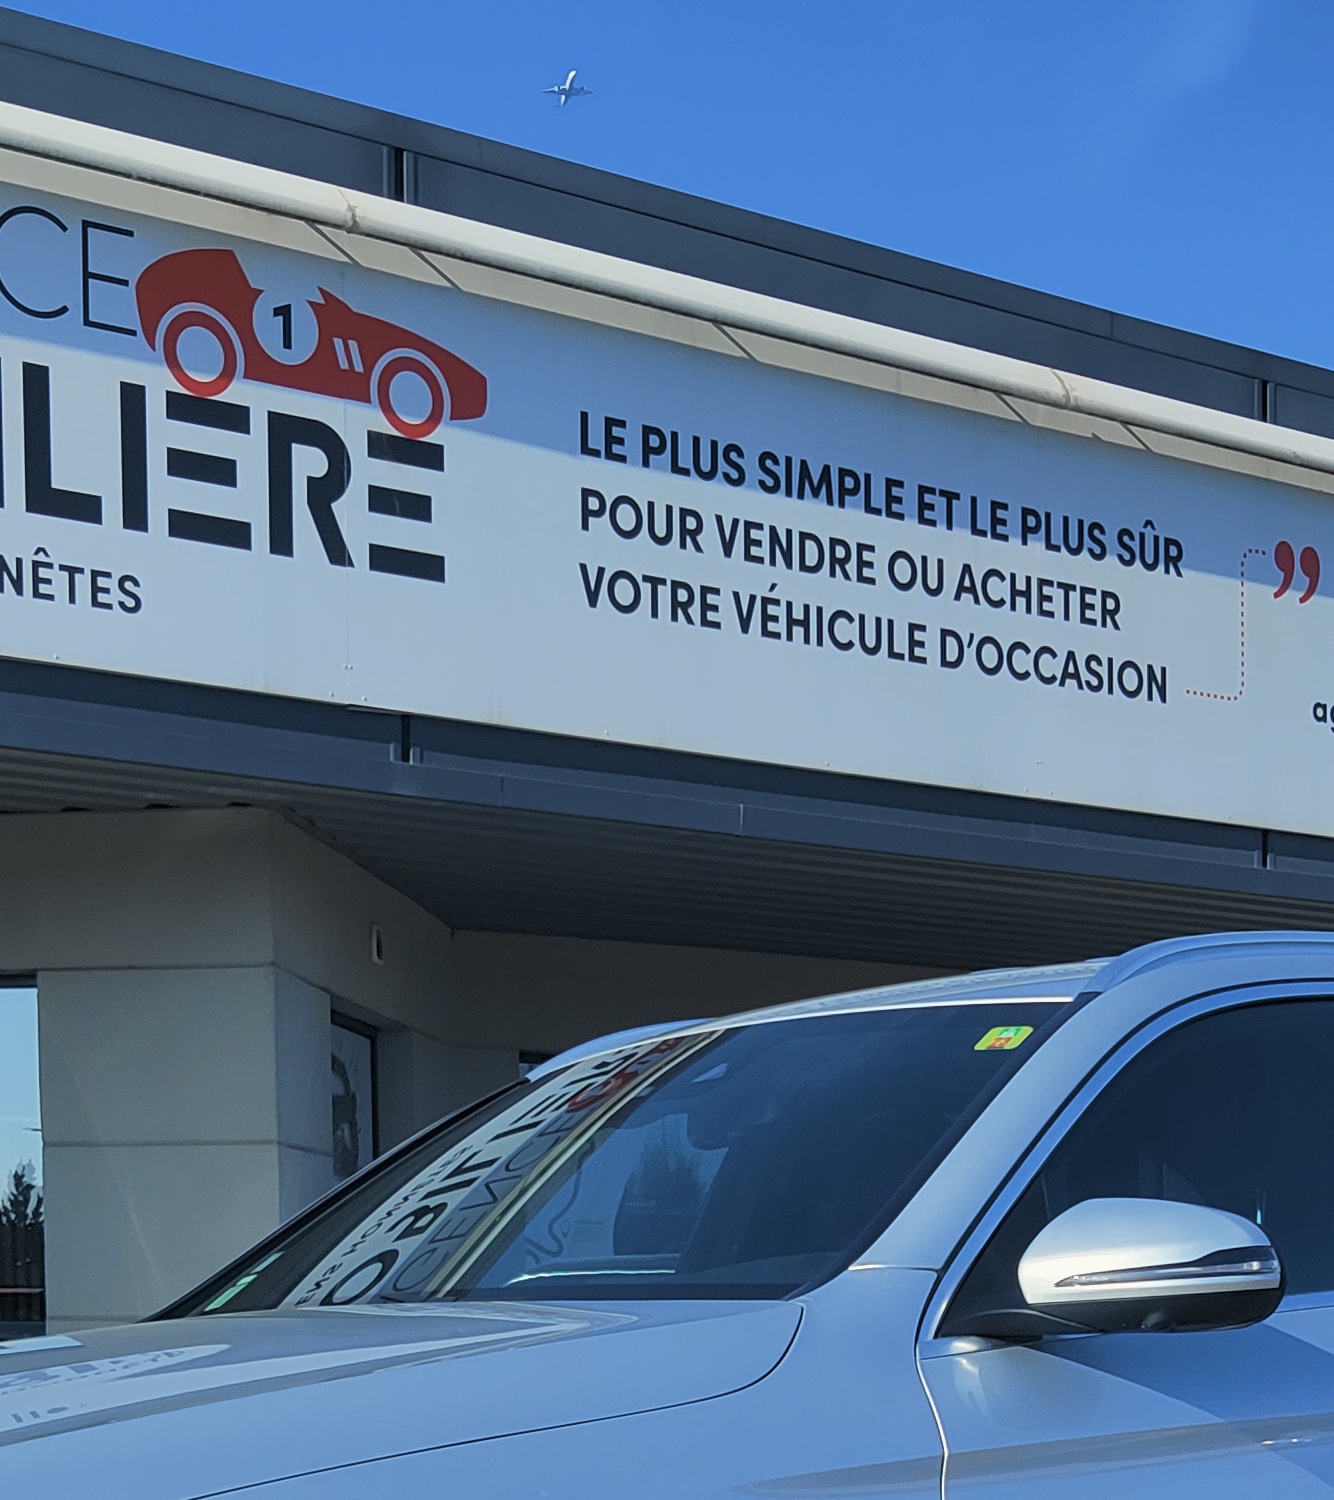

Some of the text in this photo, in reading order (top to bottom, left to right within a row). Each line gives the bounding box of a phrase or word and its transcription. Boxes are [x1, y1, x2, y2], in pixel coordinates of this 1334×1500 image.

[580, 411, 1183, 578] LE PLUS SIMPLE ET LE PLUS SÛR
[581, 487, 1121, 631] POUR VENDRE OU ACHETER
[579, 562, 1167, 704] VOTRE VÉHICULE D'OCCASION
